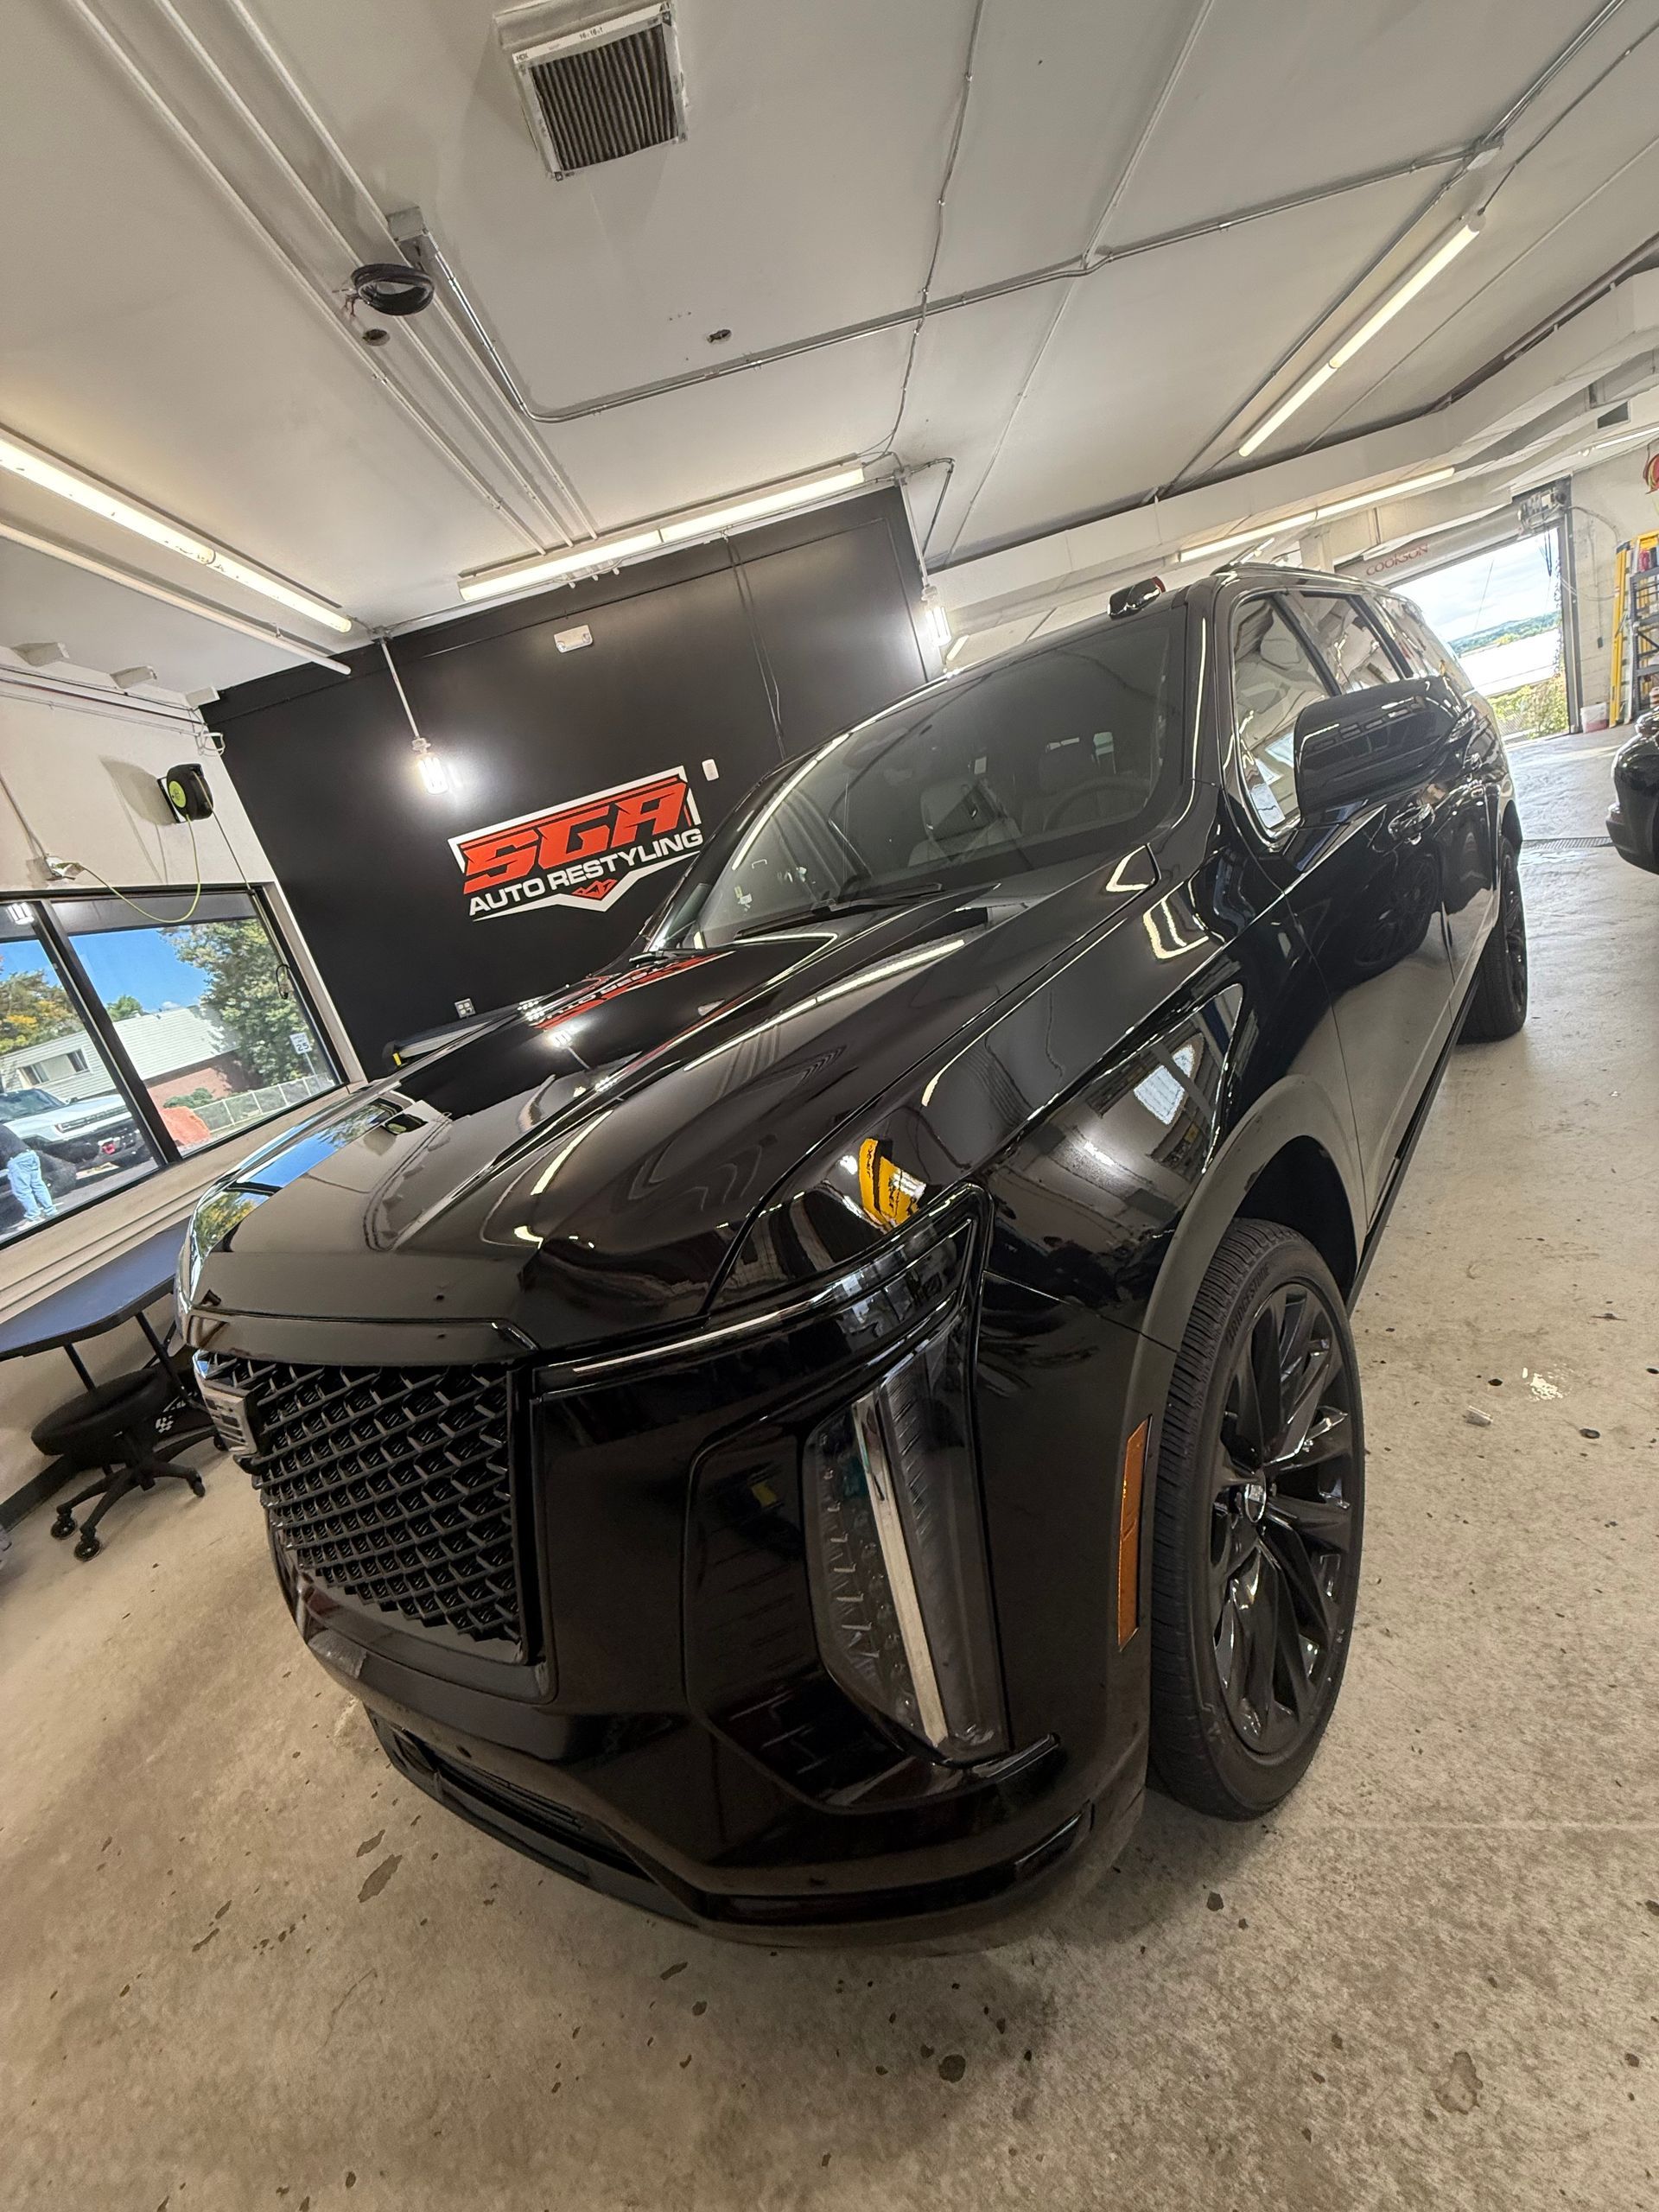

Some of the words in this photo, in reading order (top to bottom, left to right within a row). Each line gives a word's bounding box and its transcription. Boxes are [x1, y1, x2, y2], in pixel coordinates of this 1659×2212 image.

[1366, 542, 1429, 576] COOKSON
[463, 781, 687, 894] SGA
[469, 878, 546, 916] AUTO
[548, 829, 704, 890] RESTYLING
[296, 1042, 309, 1052] 25
